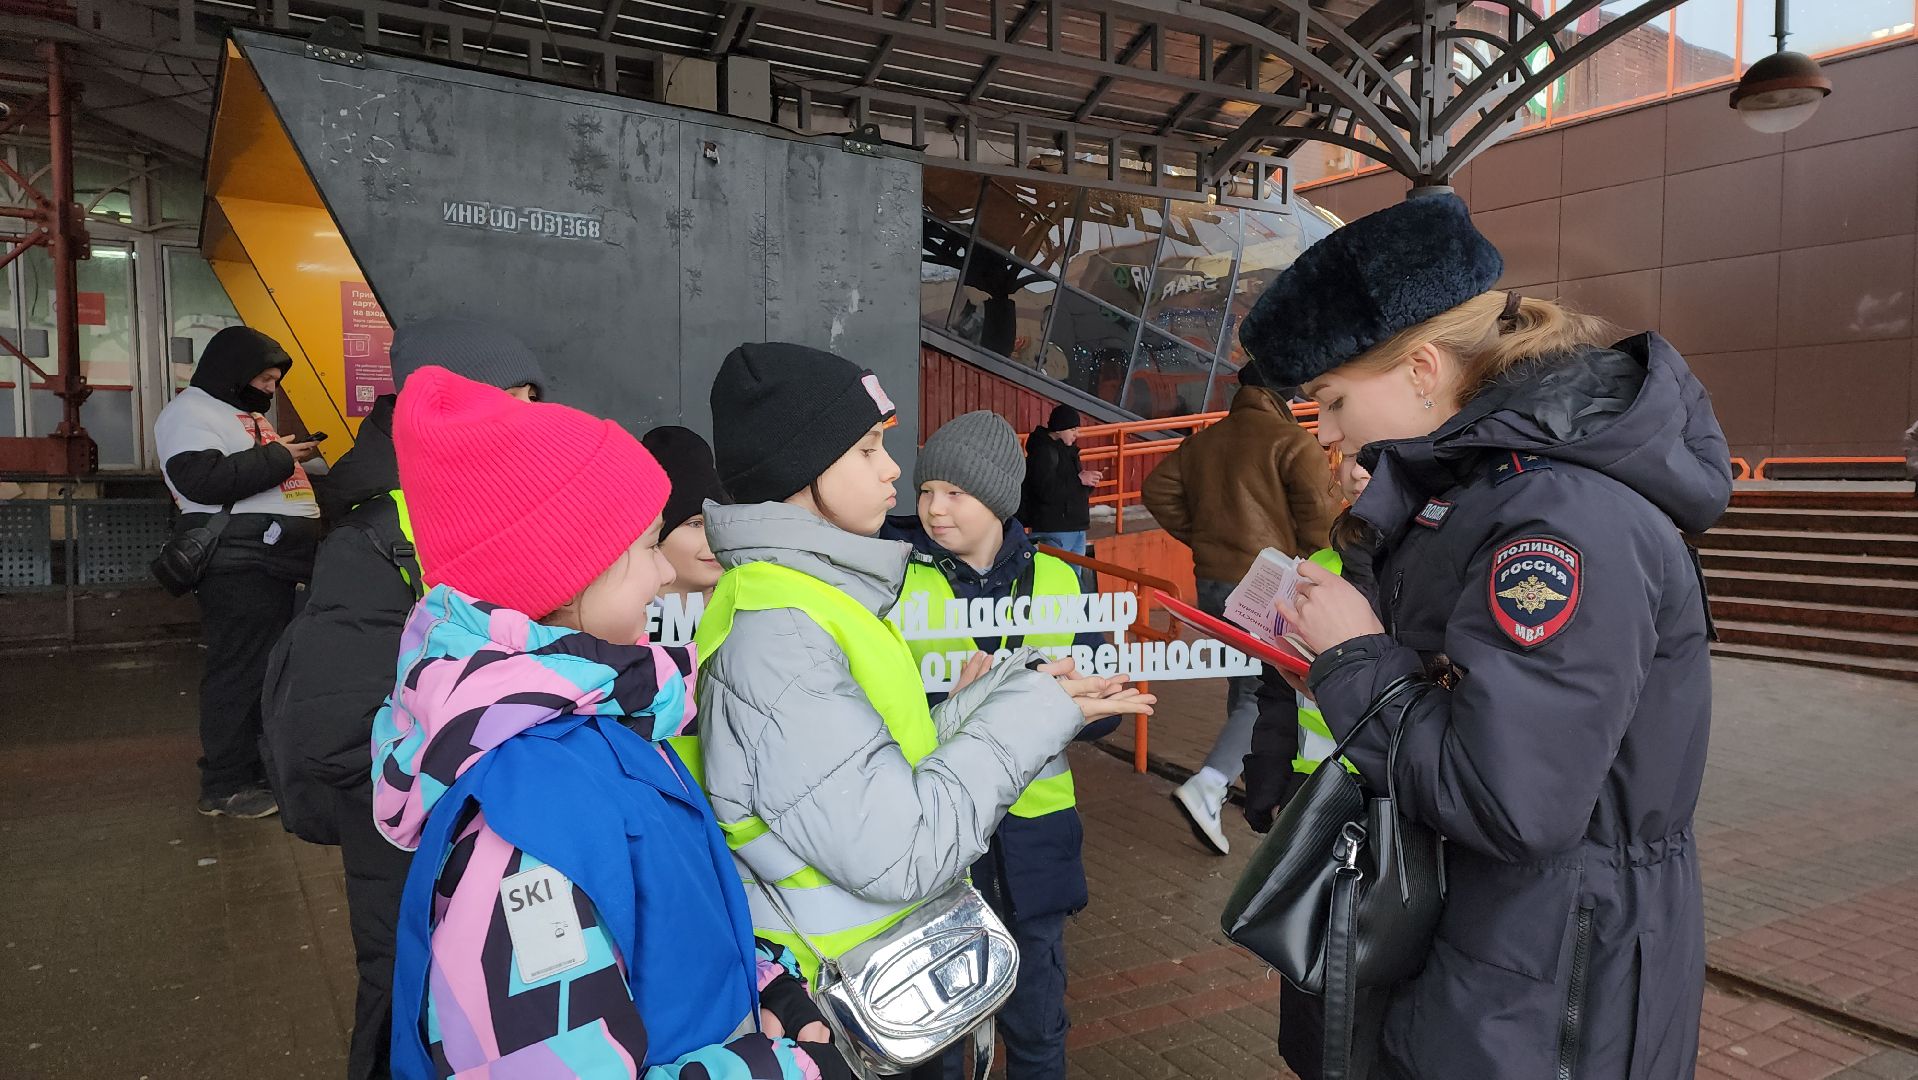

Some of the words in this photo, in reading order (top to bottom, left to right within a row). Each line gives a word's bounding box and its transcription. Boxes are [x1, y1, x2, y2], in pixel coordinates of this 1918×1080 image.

[1497, 542, 1575, 569] ПОЛИЦИЯ
[1500, 560, 1567, 586] РОССИЯ
[944, 591, 1138, 644] пассажир
[1515, 623, 1545, 642] МВД
[508, 878, 553, 913] SKI
